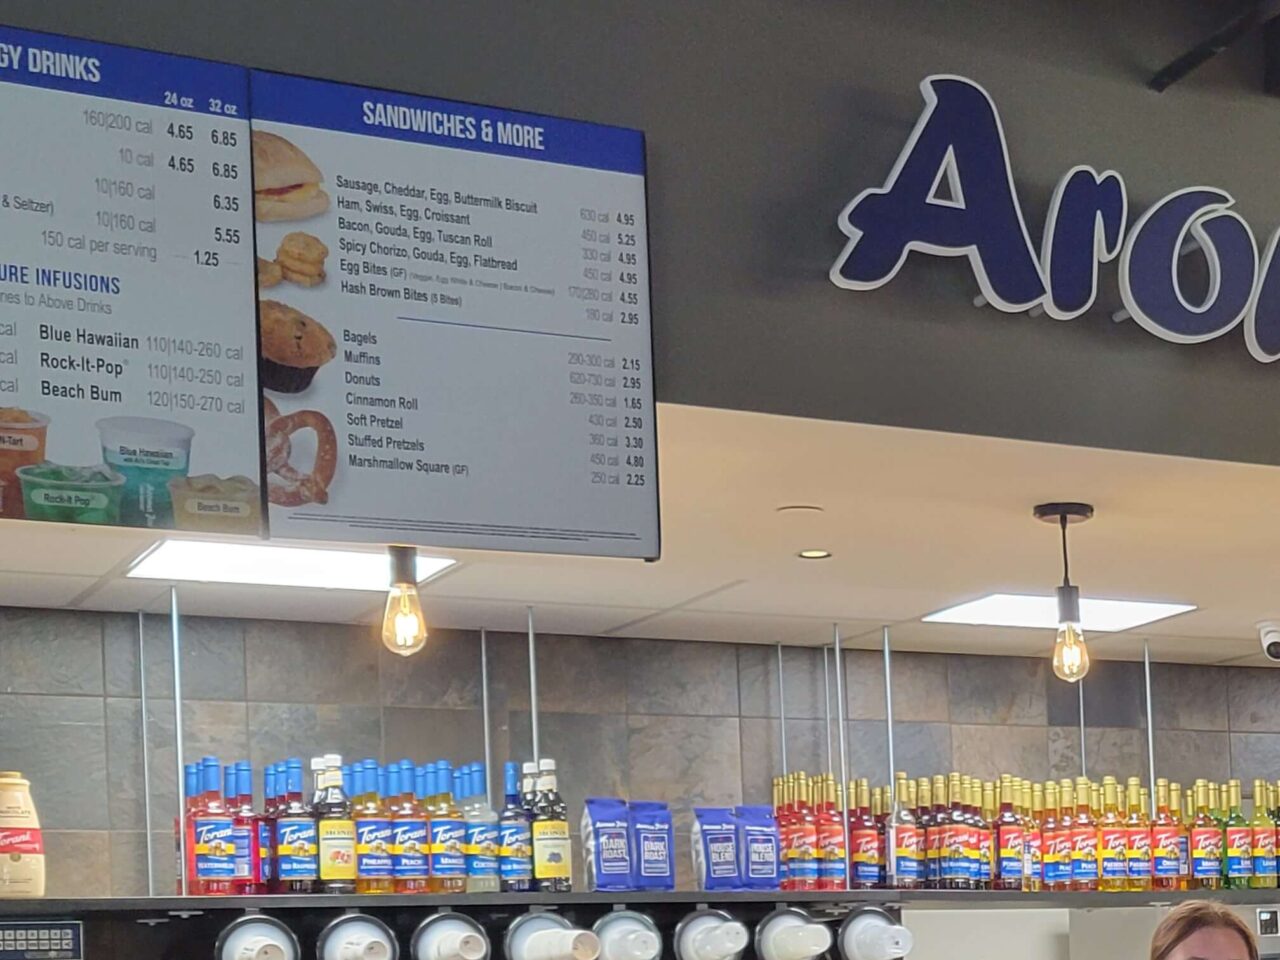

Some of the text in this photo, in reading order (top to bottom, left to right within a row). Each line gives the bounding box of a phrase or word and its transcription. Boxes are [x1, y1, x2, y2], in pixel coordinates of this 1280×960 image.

[28, 48, 101, 83] DRINKS
[164, 91, 238, 115] 24 oz 32 oz
[135, 119, 152, 134] cal
[167, 122, 193, 140] 4.65
[211, 129, 237, 147] 6.85
[363, 101, 545, 150] SANDWICHES & MORE
[119, 148, 238, 180] 10 cal 4.65 6.85
[137, 184, 156, 200] cal
[213, 195, 239, 212] 6.35
[336, 175, 381, 195] Sausage,
[384, 181, 427, 200] Cheddar,
[454, 192, 502, 209] Buttermilk
[505, 198, 538, 214] Biscuit
[617, 212, 635, 226] 4.95
[13, 196, 54, 215] Seltzer)
[139, 218, 156, 233] cal
[215, 228, 240, 244] 5.55
[337, 196, 362, 212] Ham,
[365, 199, 397, 217] Swiss,
[424, 207, 471, 225] Croissant
[617, 233, 636, 246] 5.25
[41, 230, 219, 267] 150 cal per serving 1.25
[338, 217, 373, 234] Bacon,
[375, 222, 410, 239] Gouda,
[438, 230, 471, 246] Tuscan
[474, 234, 493, 249] Roll
[618, 252, 637, 265] 4.95
[339, 238, 367, 256] Spicy
[369, 241, 410, 260] Chorizo,
[413, 247, 448, 265] Gouda,
[474, 254, 518, 272] Flatbread
[619, 272, 638, 285] 4.95
[35, 267, 121, 295] INFUSIONS
[340, 259, 360, 276] Egg
[362, 261, 388, 276] Bites
[390, 266, 407, 281] (GF)
[620, 291, 638, 305] 4.55
[24, 293, 112, 315] to Above Drinks
[341, 280, 366, 295] Hash
[369, 283, 400, 299] Brown
[404, 287, 428, 302] Bites
[621, 312, 639, 325] 2.95
[39, 324, 71, 342] Blue
[76, 328, 139, 350] Hawaiian
[225, 346, 243, 361] cal
[343, 329, 377, 346] Bagels
[622, 358, 641, 371] 2.15
[40, 352, 123, 378] Rock-It-Pop
[226, 373, 244, 387] cal
[344, 350, 381, 365] Muffins
[623, 376, 641, 389] 2.95
[41, 380, 85, 400] Beach
[90, 385, 122, 402] Bum
[227, 399, 245, 414] cal
[345, 371, 381, 386] Donuts
[624, 397, 642, 410] 1.65
[346, 392, 396, 409] Cinnamon
[398, 396, 418, 410] Roll
[624, 416, 642, 429] 2.50
[347, 412, 367, 427] Soft
[370, 414, 403, 429] Pretzel
[625, 436, 643, 449] 3.30
[348, 434, 383, 449] Stuffed
[386, 436, 425, 451] Pretzels
[626, 455, 644, 468] 4.80
[349, 454, 413, 472] Marshmallow
[416, 459, 450, 476] Square
[627, 474, 645, 487] 2.25
